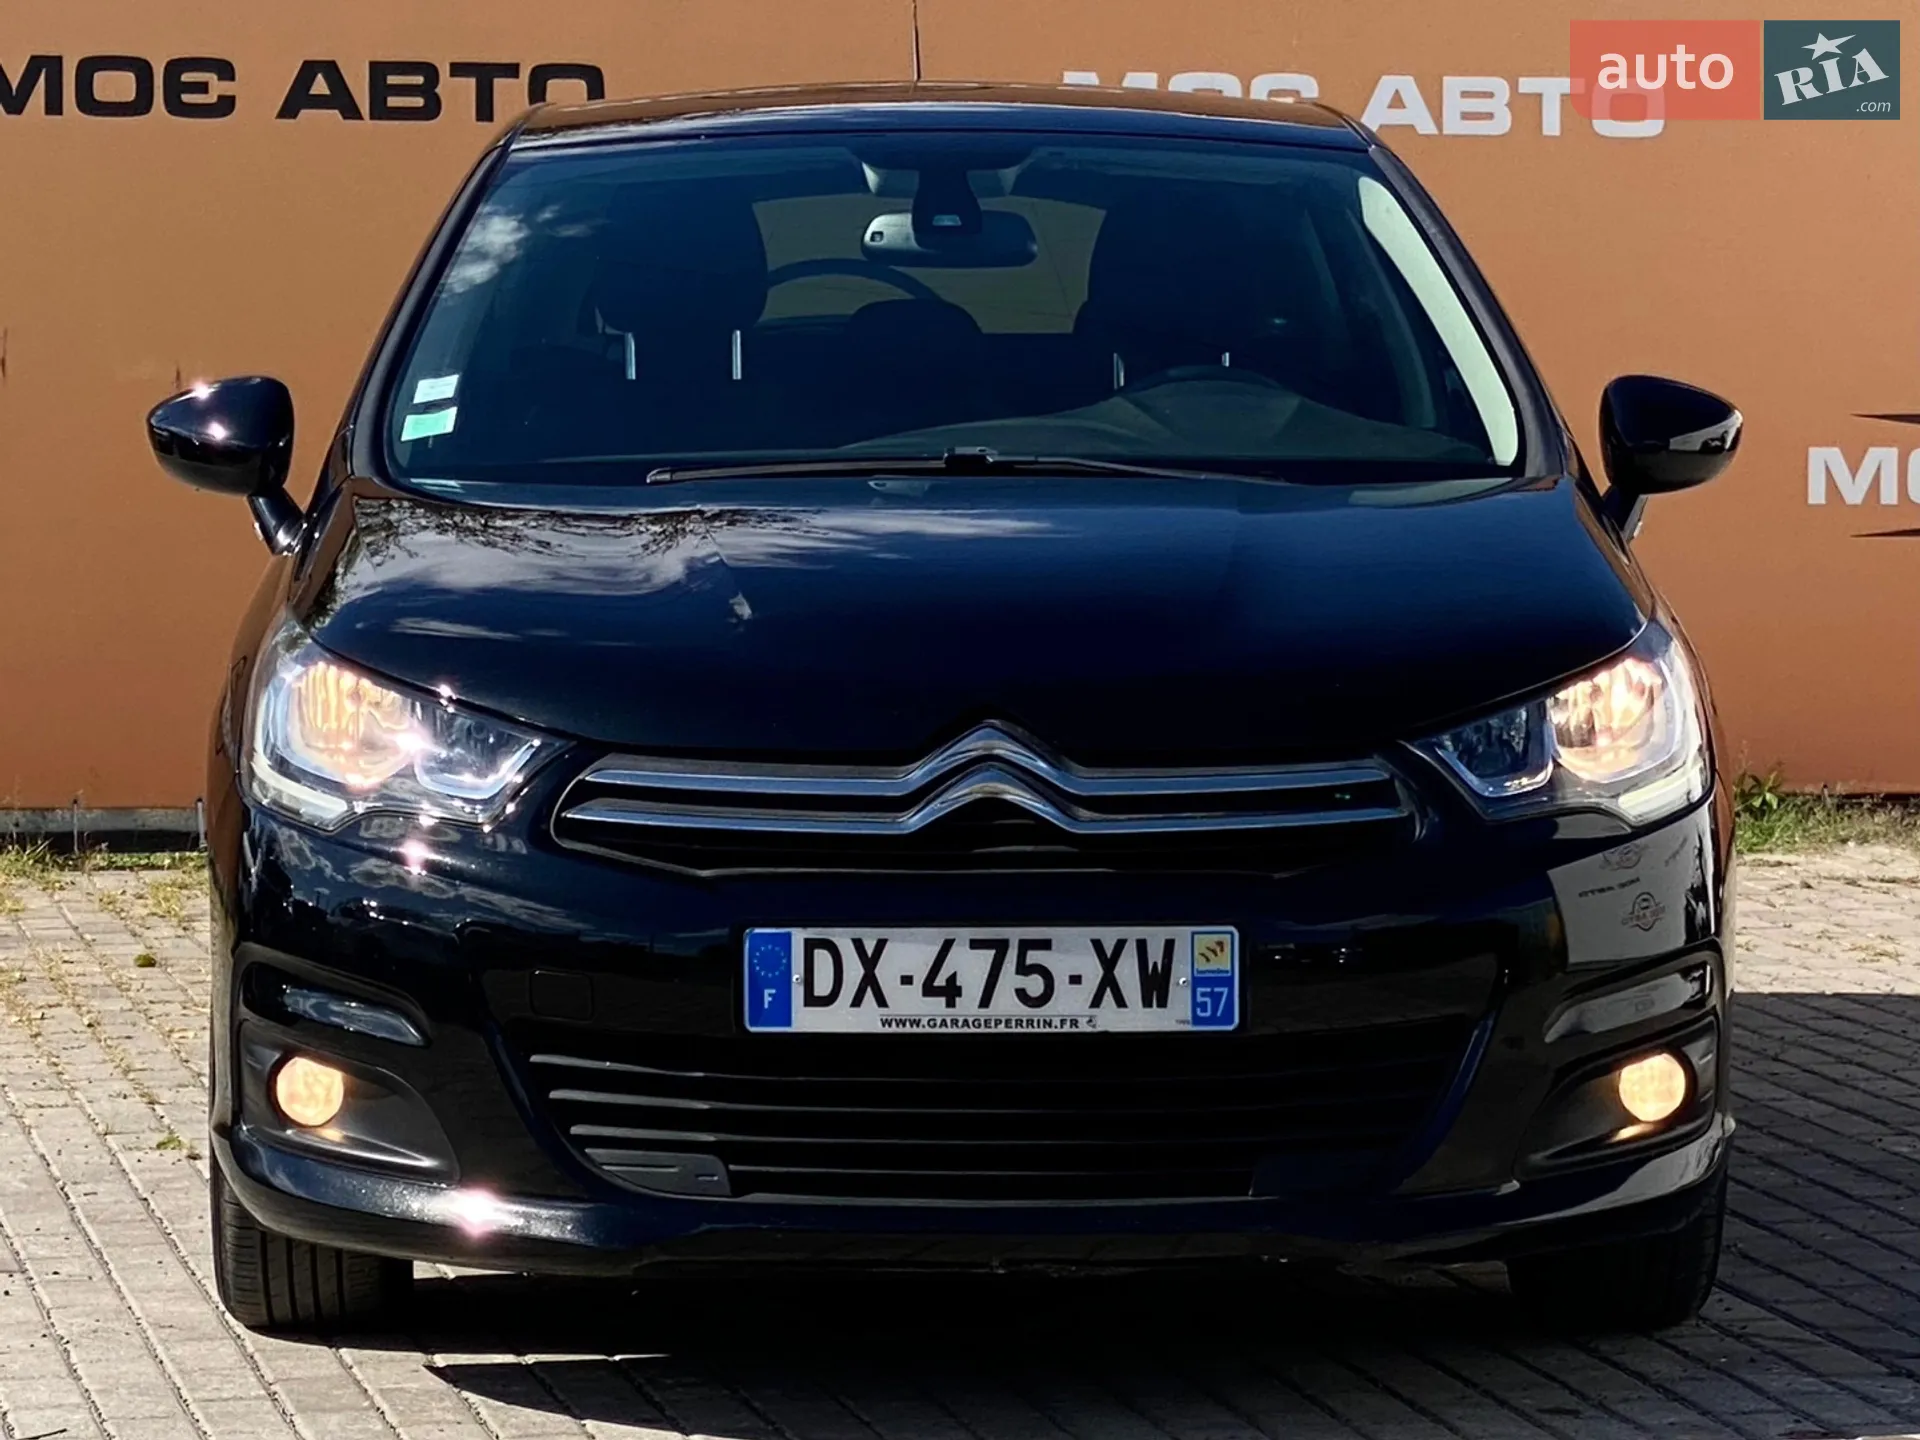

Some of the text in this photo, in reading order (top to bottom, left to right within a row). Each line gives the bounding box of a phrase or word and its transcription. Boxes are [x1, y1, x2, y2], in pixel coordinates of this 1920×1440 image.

[1807, 446, 1920, 505] М
[763, 988, 776, 1009] F
[1196, 986, 1229, 1017] 57
[879, 1017, 1080, 1030] WWW.GARAGEPERRIN.FR
